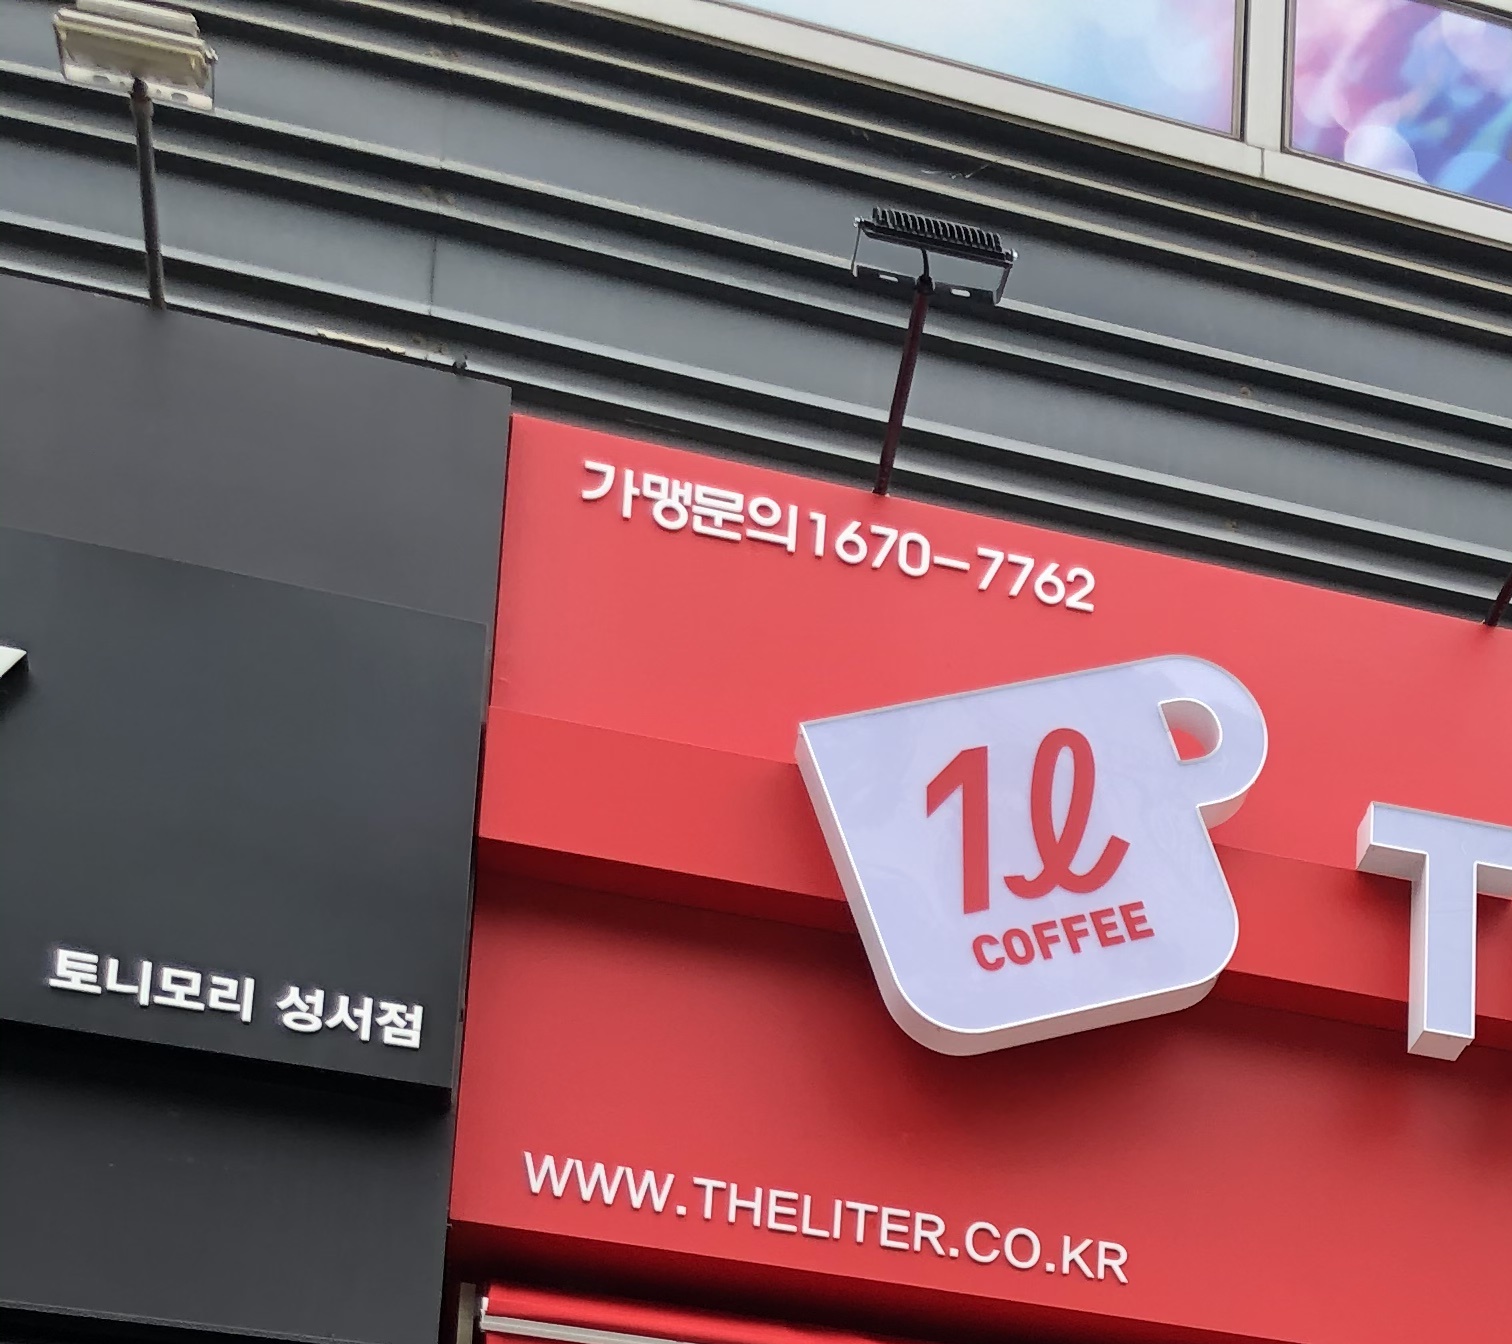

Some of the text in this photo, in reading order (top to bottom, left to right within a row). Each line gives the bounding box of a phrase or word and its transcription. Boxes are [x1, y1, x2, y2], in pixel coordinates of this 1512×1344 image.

[972, 900, 1155, 972] COFFEE
[48, 947, 424, 1049] 토니모리 성서점
[522, 1149, 1129, 1284] WWW.THELITER.CO.KR
